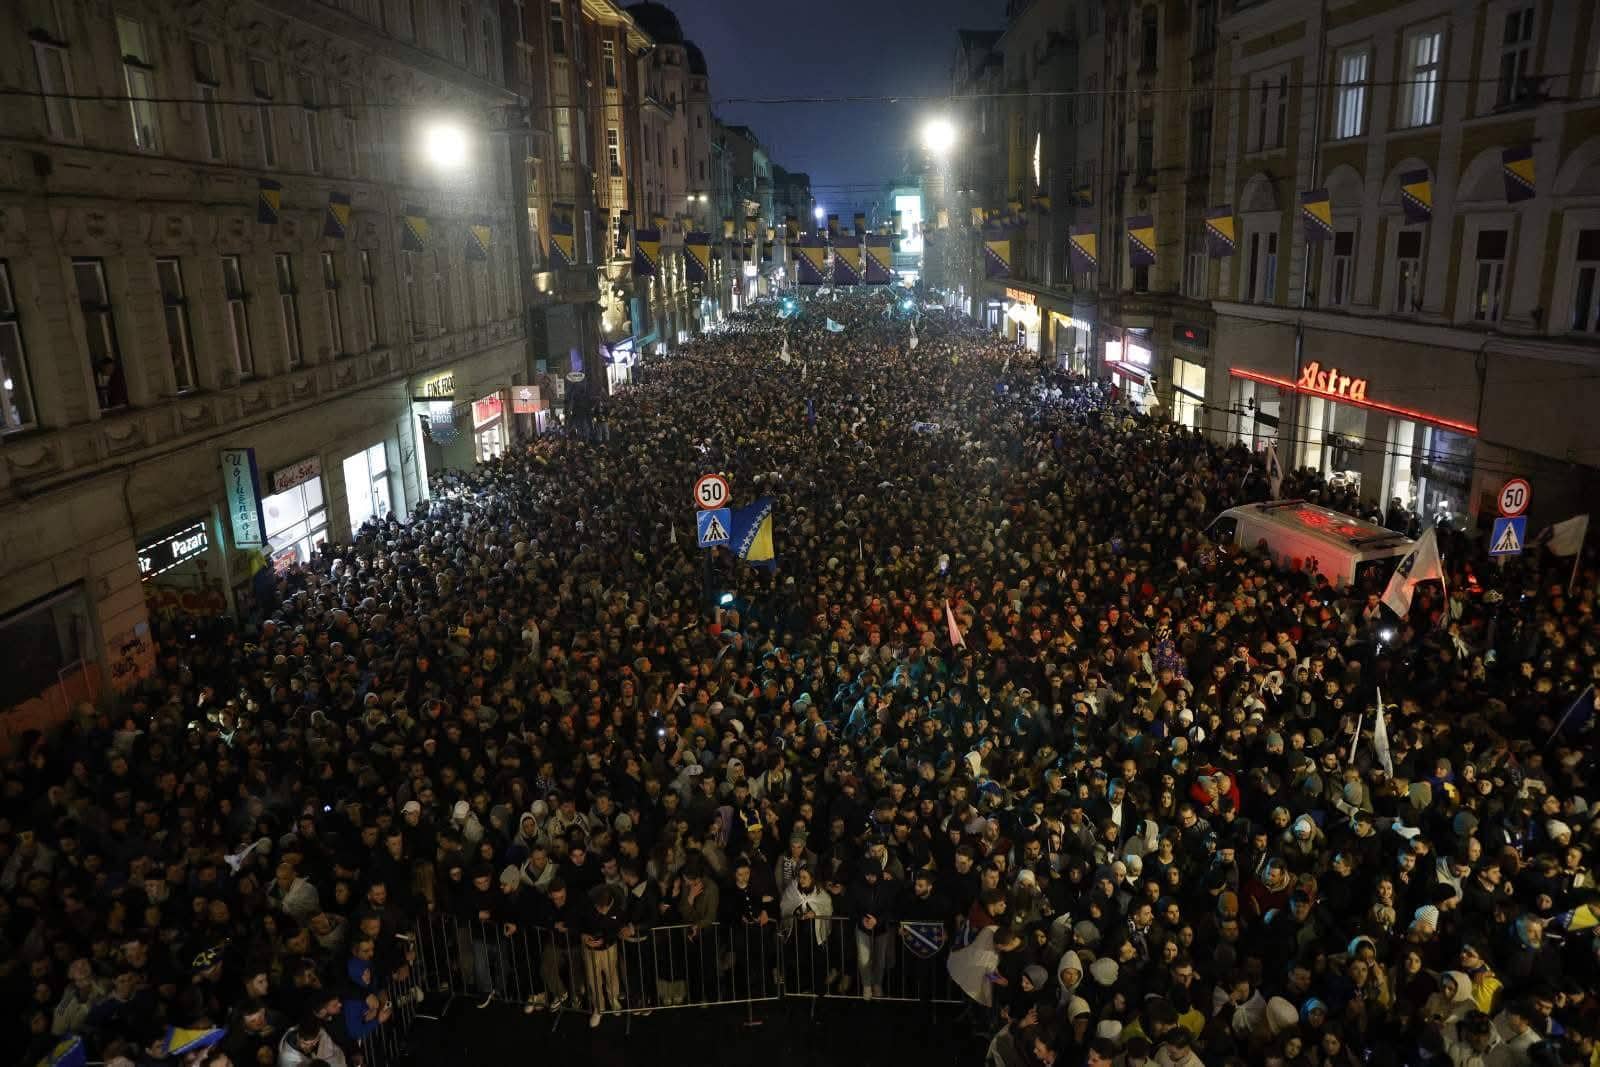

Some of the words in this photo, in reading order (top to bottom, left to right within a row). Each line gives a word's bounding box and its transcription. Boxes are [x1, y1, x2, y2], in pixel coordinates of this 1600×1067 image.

[427, 379, 441, 396] FINE
[1298, 361, 1366, 400] Astra
[702, 483, 722, 501] 50
[1504, 489, 1524, 508] 50
